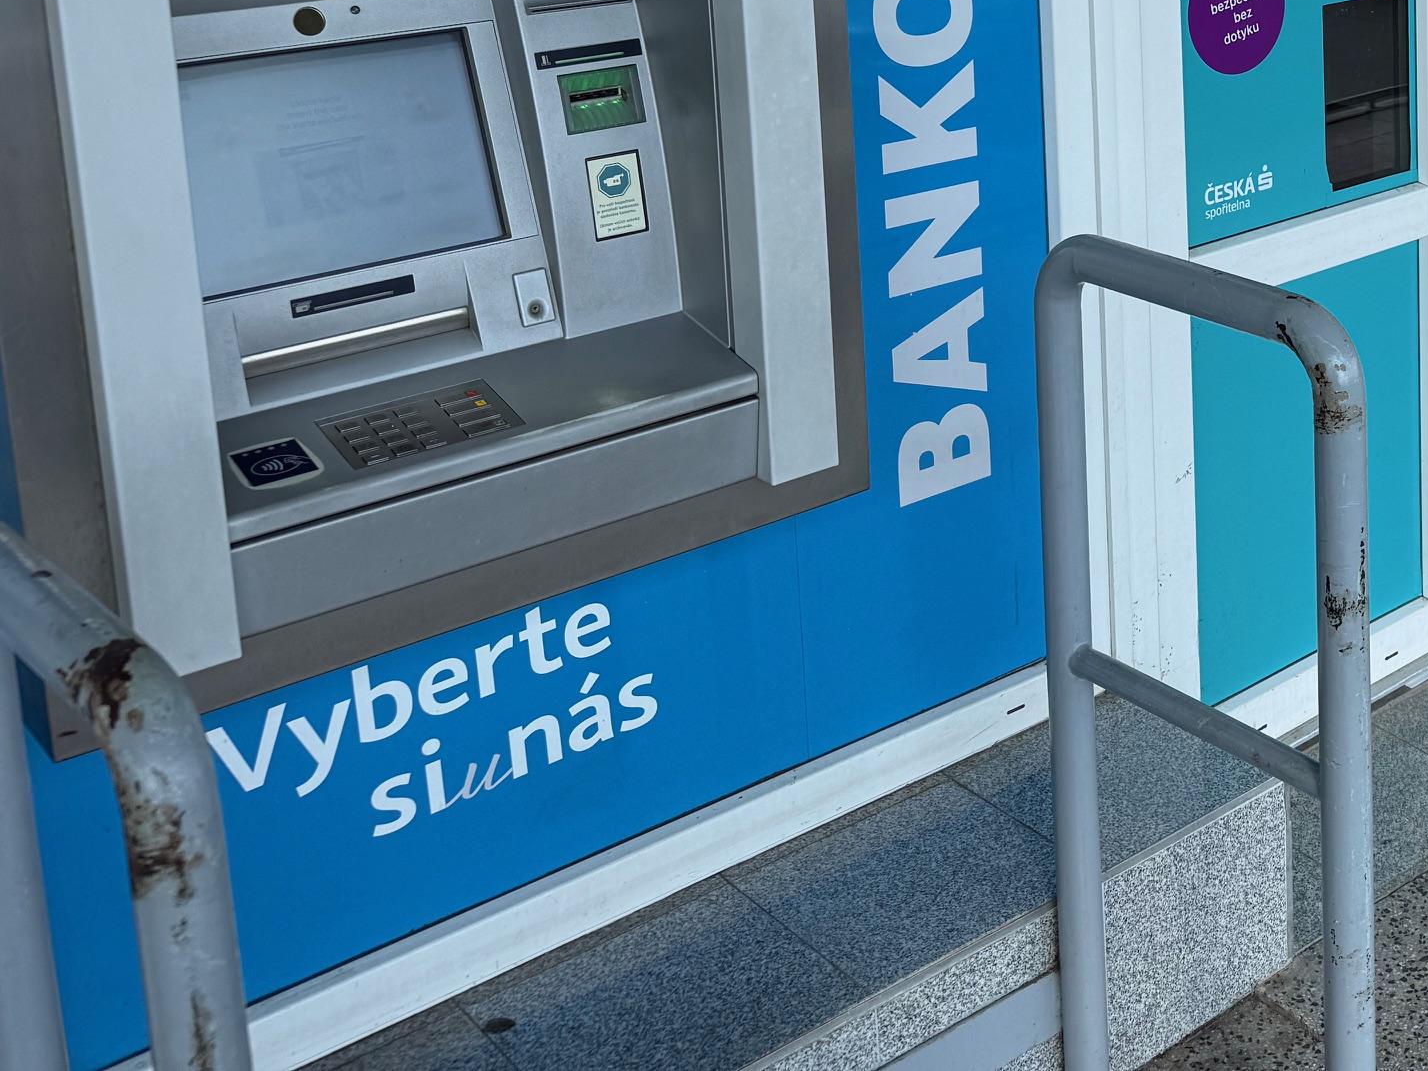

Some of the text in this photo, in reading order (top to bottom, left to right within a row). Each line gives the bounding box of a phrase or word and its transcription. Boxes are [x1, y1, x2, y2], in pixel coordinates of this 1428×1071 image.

[1233, 7, 1253, 24] bez
[1223, 22, 1260, 46] dotyku
[1203, 172, 1256, 206] ČESKÁ
[1204, 197, 1251, 220] spořitelna
[205, 601, 613, 798] Vyberte
[369, 737, 449, 837] si
[508, 671, 659, 781] nás
